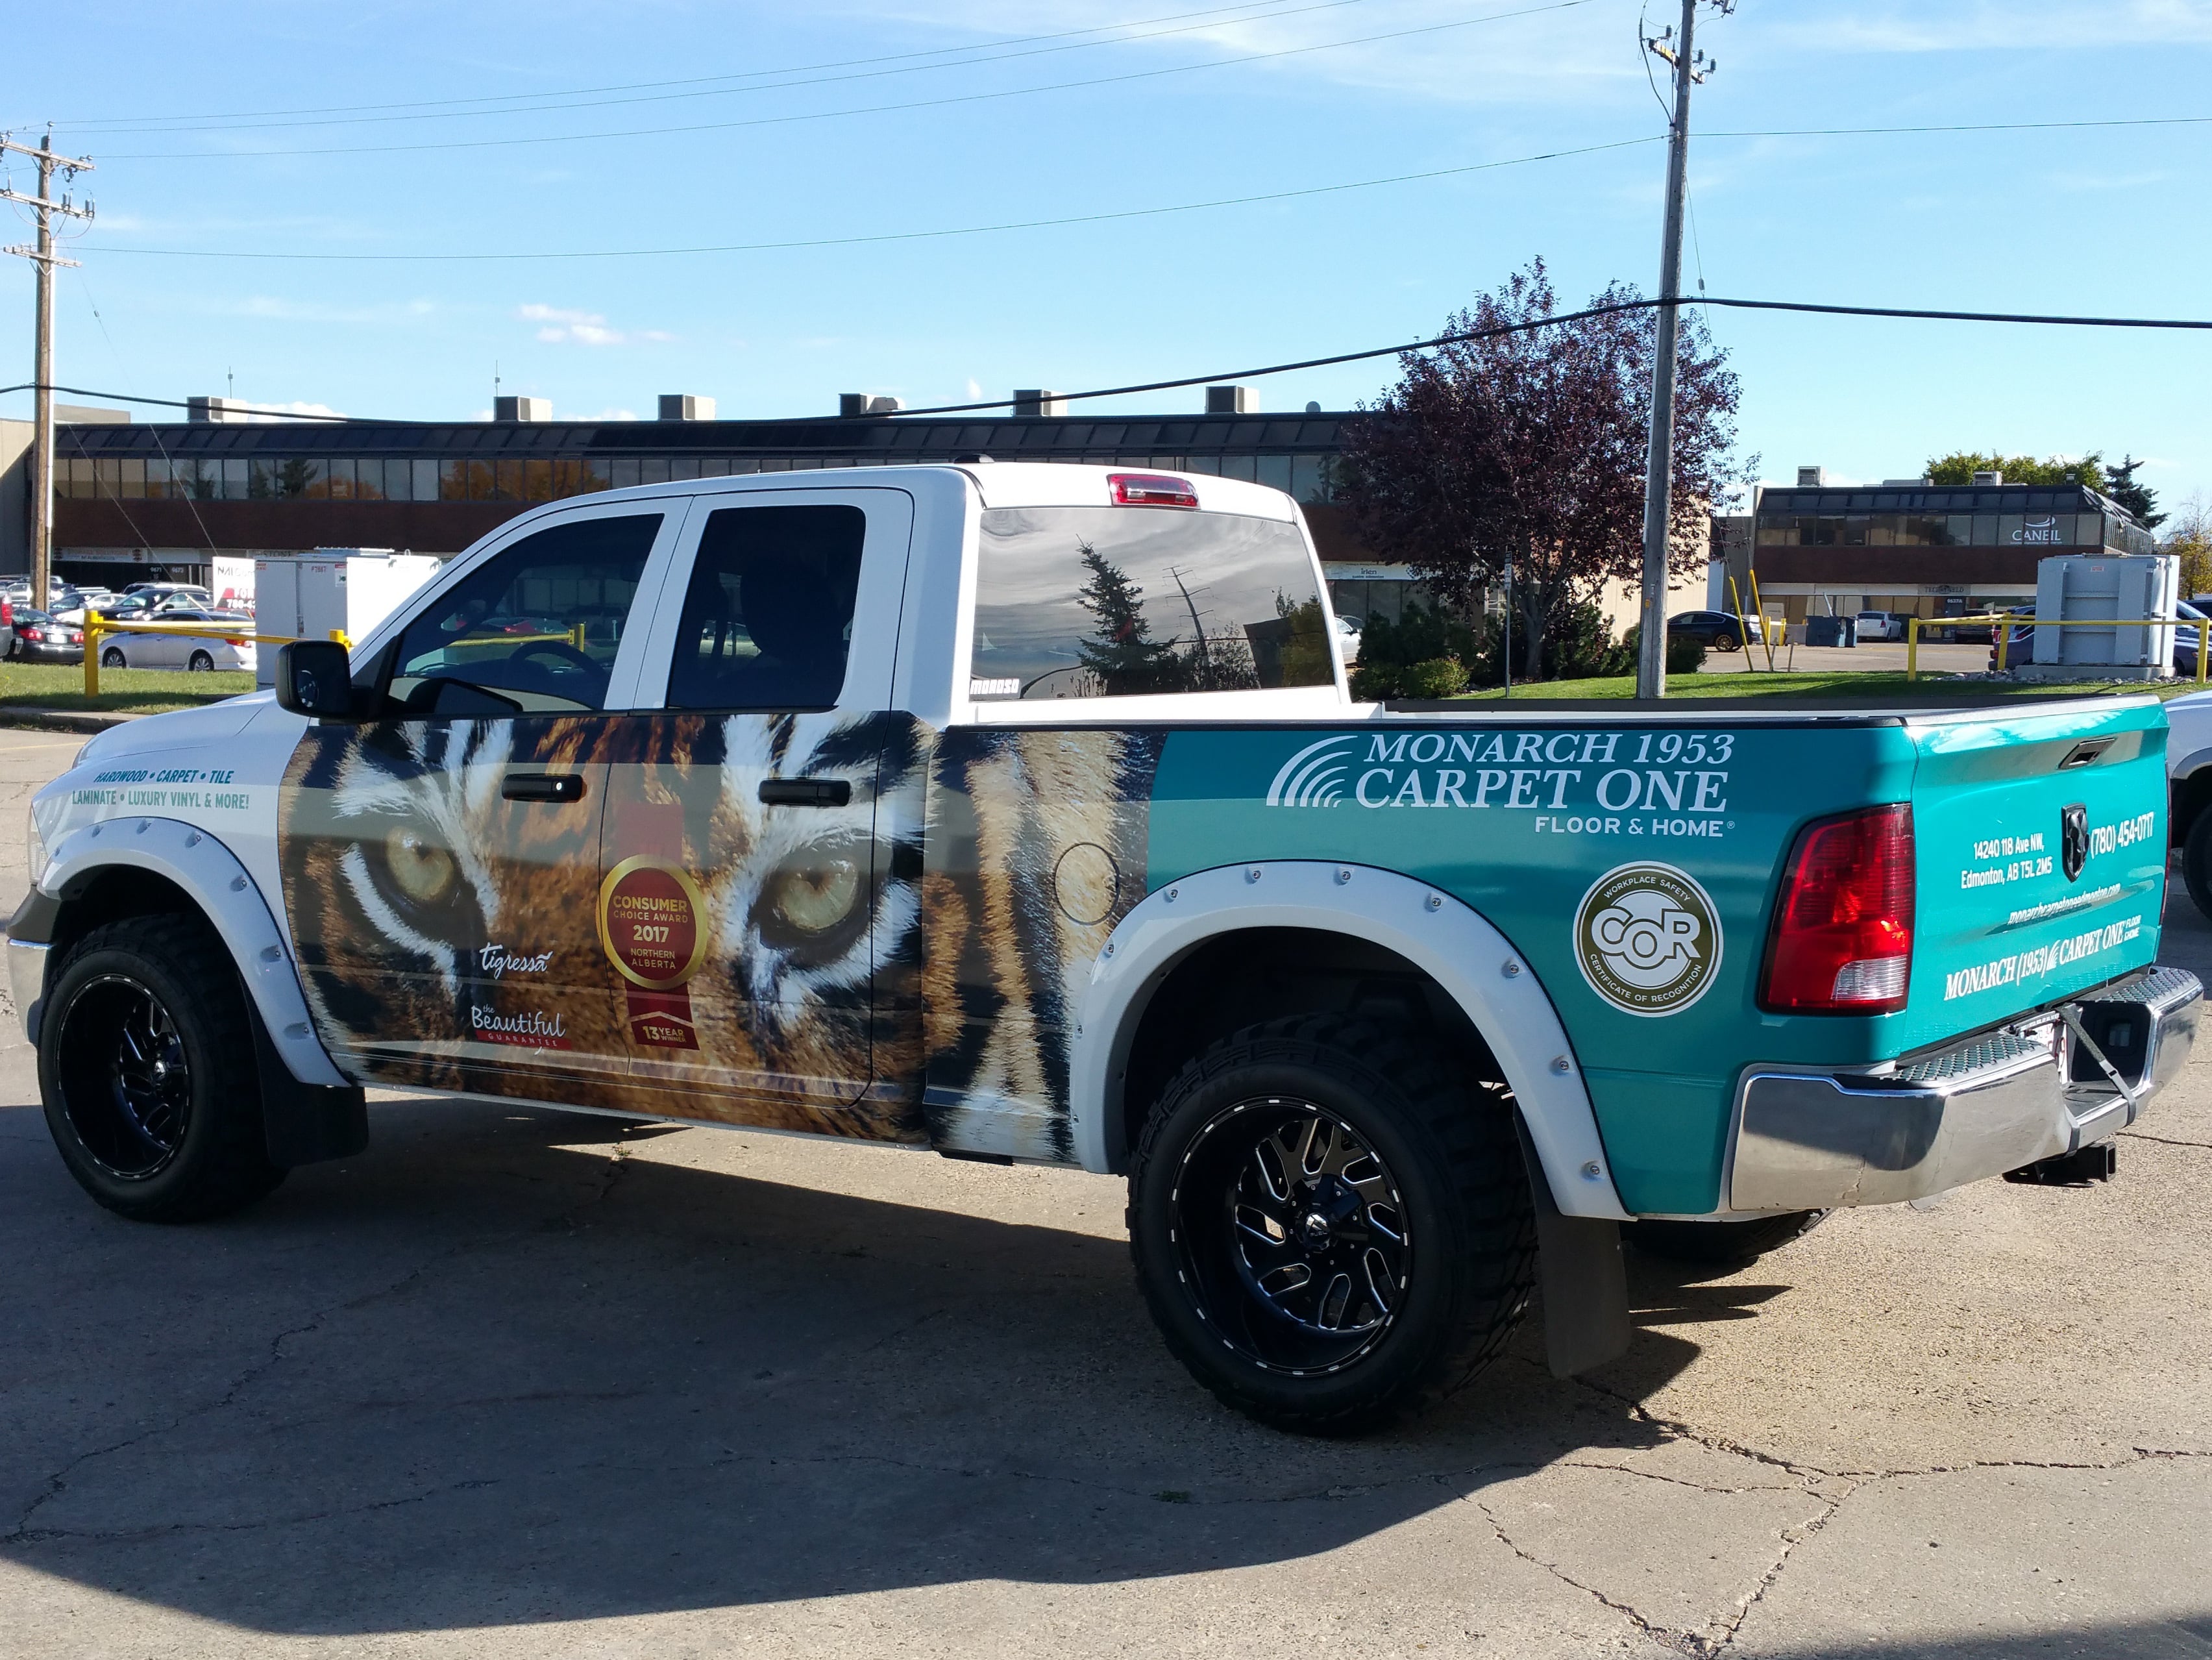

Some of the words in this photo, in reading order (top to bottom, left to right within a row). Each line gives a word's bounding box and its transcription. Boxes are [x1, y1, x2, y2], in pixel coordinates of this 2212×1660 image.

[2012, 529, 2061, 541] CANEIL
[1363, 734, 1623, 763] MONARCH
[1632, 734, 1735, 764] 1953
[93, 770, 149, 783] HARDWOOD
[156, 769, 199, 783] CARPET
[208, 770, 235, 784] TILE
[72, 789, 117, 805] LAMINATE
[127, 791, 167, 807] LUXURY
[170, 791, 201, 808] VINYL
[204, 793, 212, 808] &
[215, 793, 250, 810] MORE!
[1355, 768, 1582, 809] CARPET
[1596, 769, 1729, 813] ONE
[1534, 816, 1621, 834] FLOOR
[1627, 818, 1644, 835] &
[2090, 824, 2116, 860] (780)
[2117, 811, 2154, 848] 454-0717
[1973, 839, 2000, 860] 14240
[2000, 837, 2013, 856] 118
[2015, 836, 2030, 854] Ave
[2030, 832, 2045, 852] NW,
[1961, 866, 2006, 889] Edmonton,
[2006, 862, 2019, 882] AB
[2020, 860, 2035, 879] T5L
[2035, 856, 2053, 876] 2M5
[1603, 876, 1656, 899] WORKPLACE
[1659, 879, 1691, 902] SAFETY
[613, 895, 688, 913] CONSUMER
[613, 910, 650, 921] CHOICE
[653, 912, 689, 923] AWARD
[2126, 914, 2142, 929] FLOOR
[633, 924, 670, 943] 2017
[1590, 907, 1702, 971] COR
[630, 948, 676, 960] NORTHERN
[1943, 954, 2017, 1001] MONARCH
[2017, 945, 2048, 986] (1953)
[2059, 928, 2104, 965] CARPET
[2102, 921, 2126, 950] ONE
[632, 960, 676, 969] ALBERTA
[1590, 954, 1632, 998] CERTIFICATE
[1634, 994, 1648, 1002] OF
[1651, 964, 1702, 1002] RECOGNITION
[482, 1004, 495, 1013] the
[471, 1006, 566, 1055] Beautiful
[488, 1033, 558, 1047] GUARANTEE
[642, 1026, 660, 1040] 13
[659, 1026, 684, 1037] YEAR
